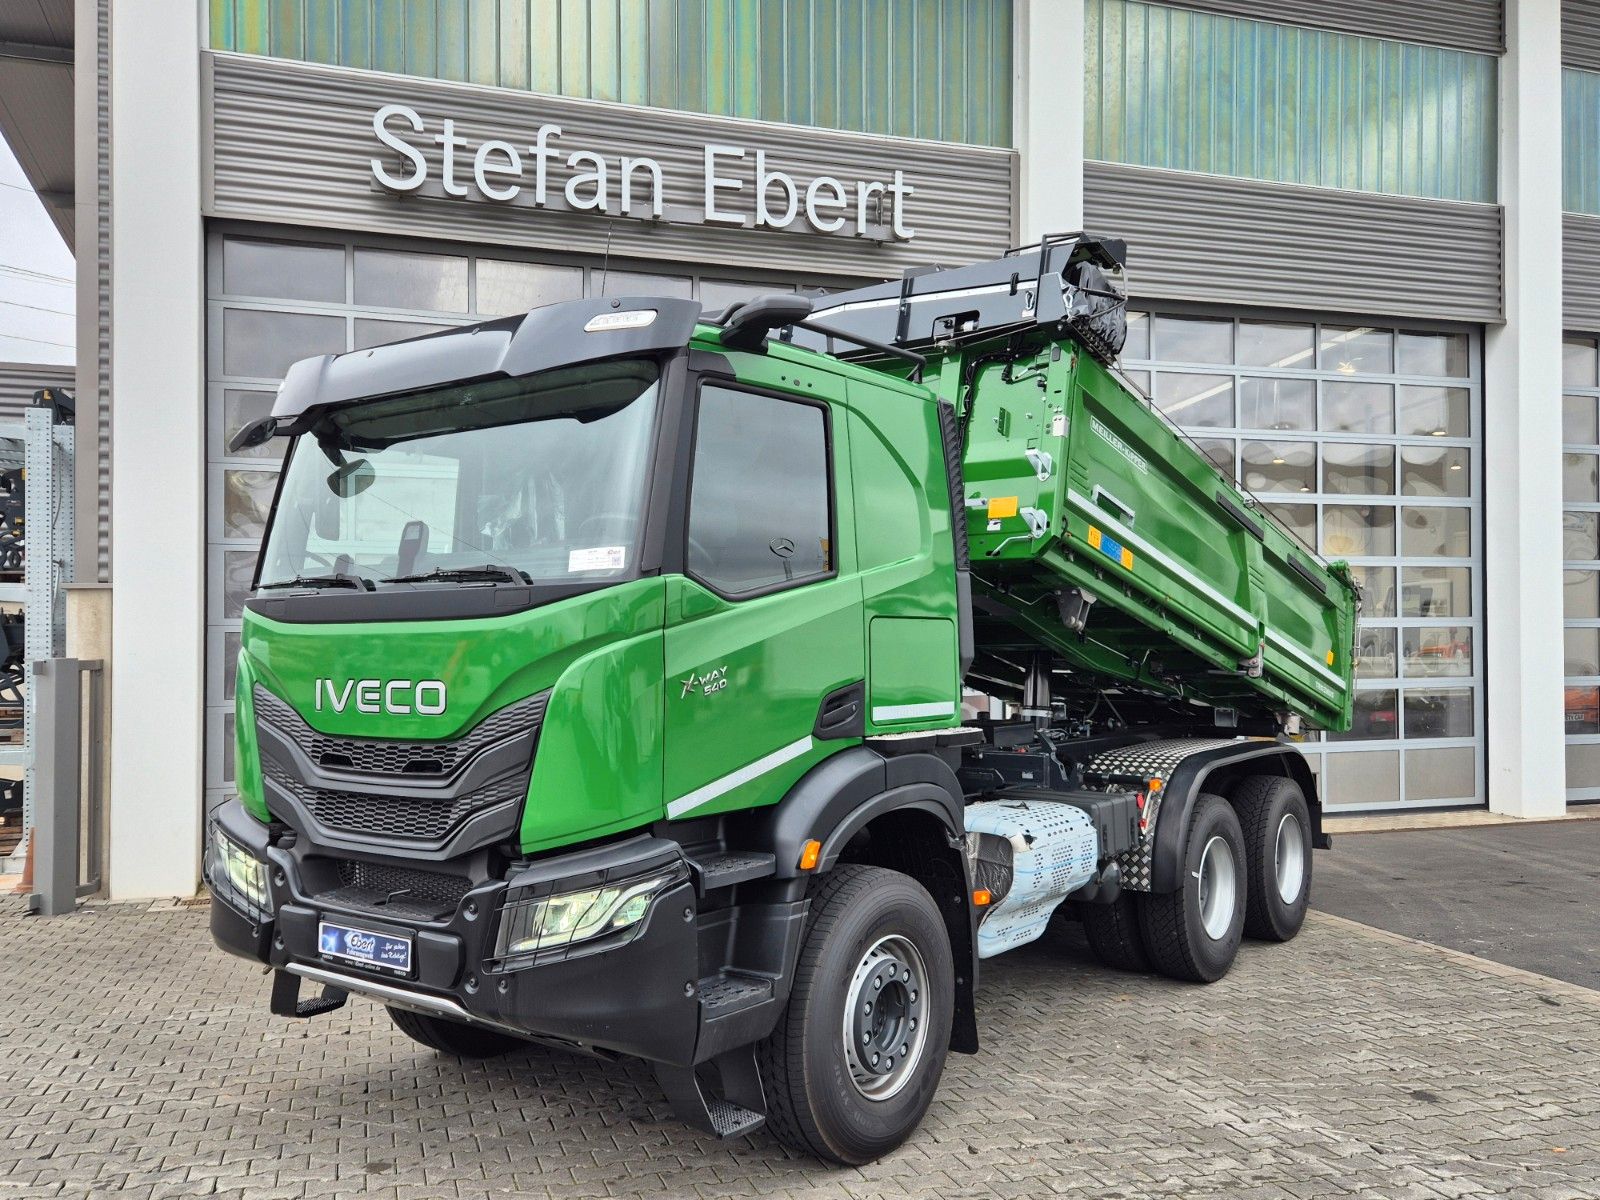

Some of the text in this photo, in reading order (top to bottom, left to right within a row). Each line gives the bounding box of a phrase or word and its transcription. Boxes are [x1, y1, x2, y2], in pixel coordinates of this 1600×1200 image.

[370, 104, 914, 242] Stefan Ebert
[315, 679, 447, 716] IVECO
[680, 665, 728, 699] X-WAY
[704, 678, 727, 696] 540
